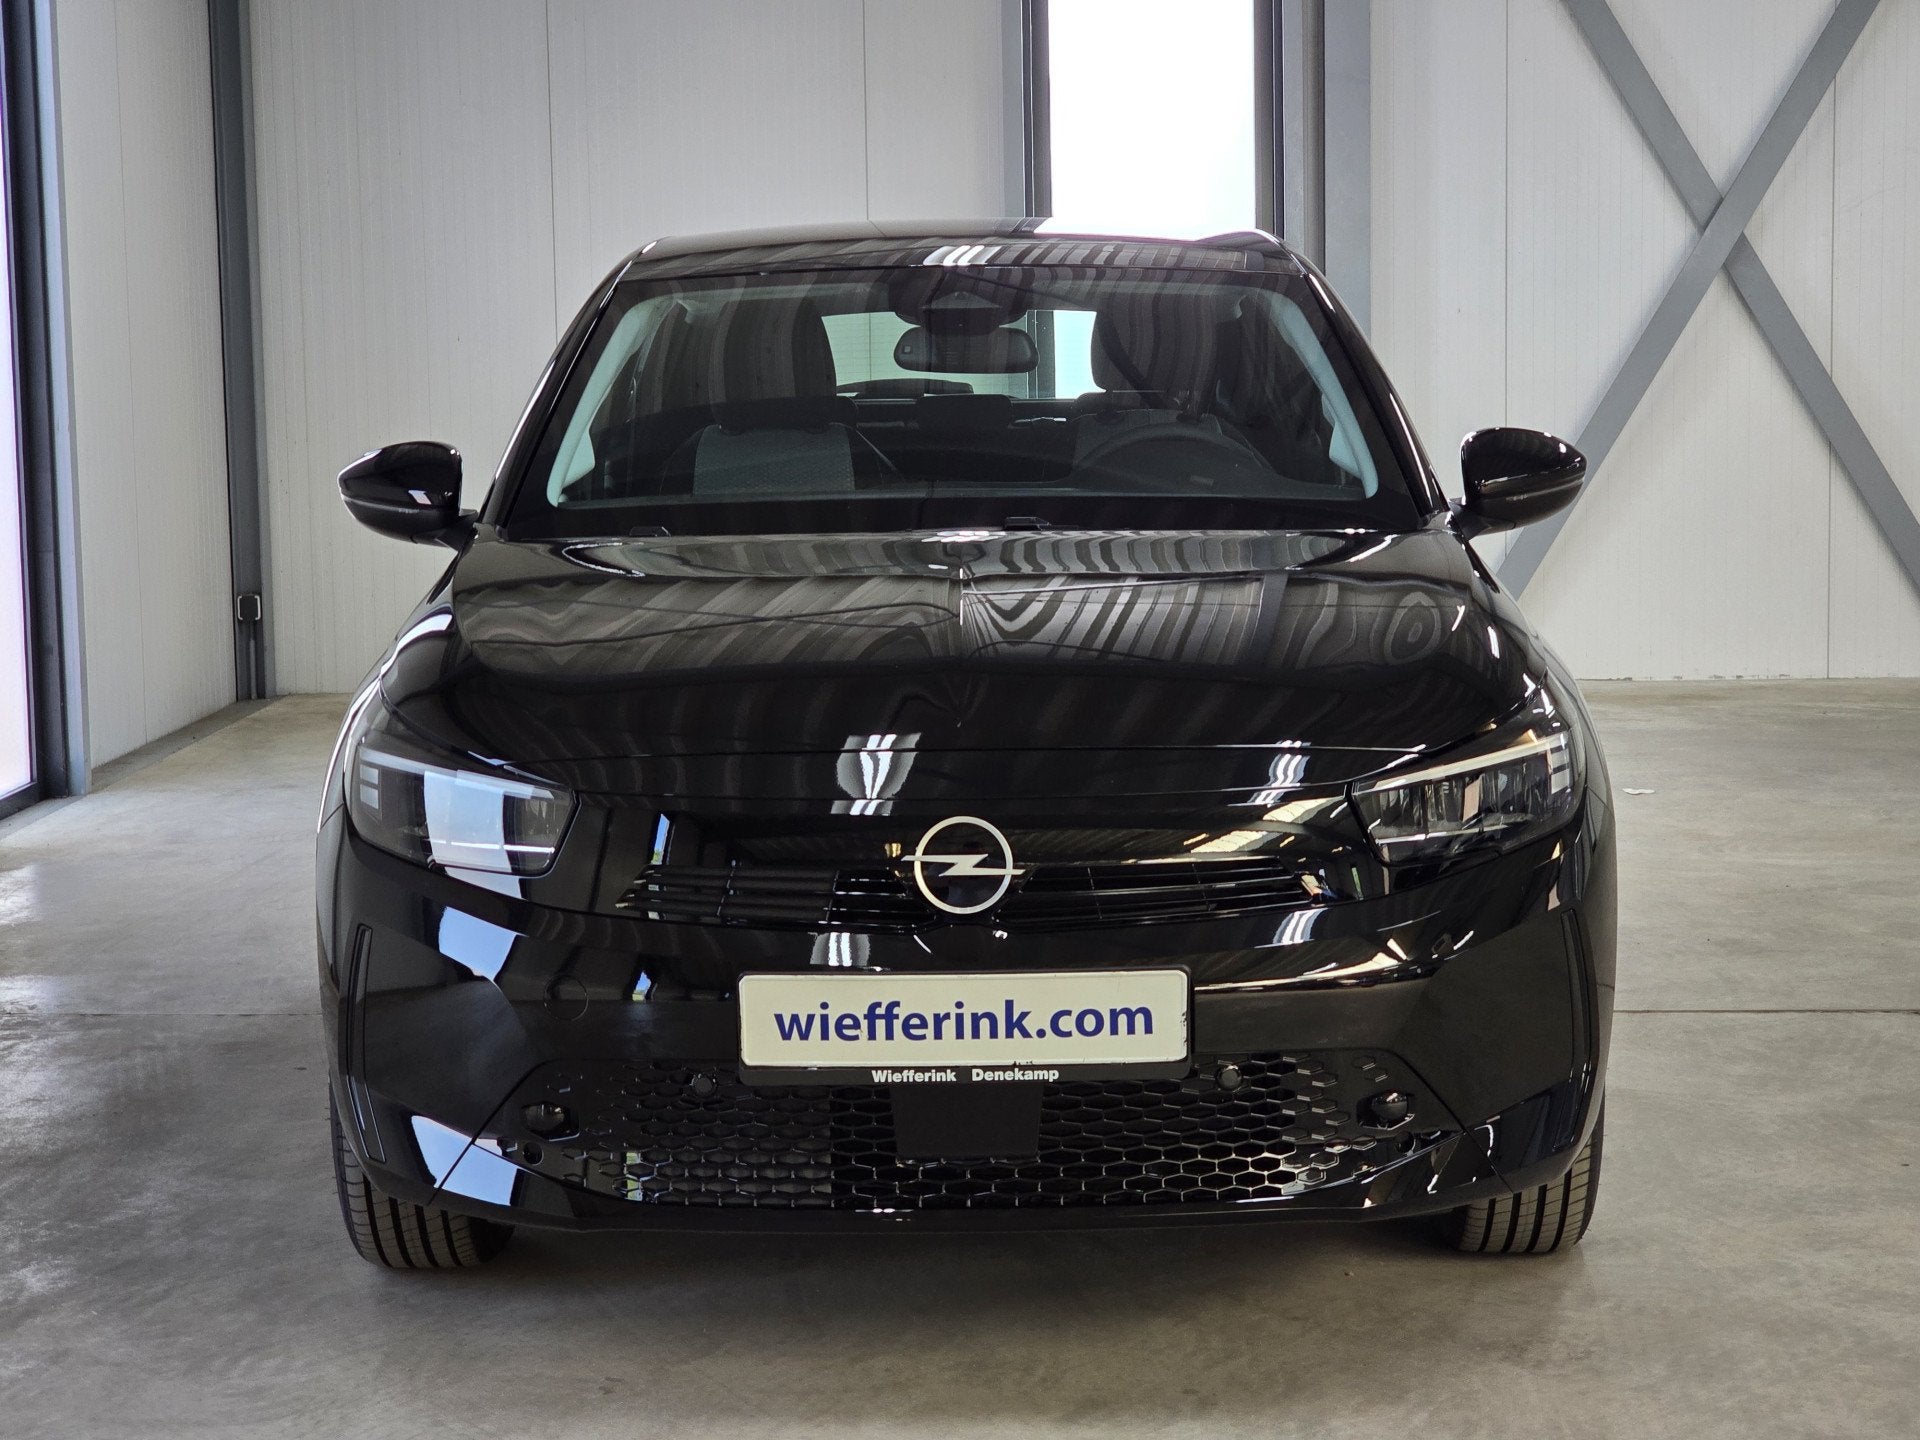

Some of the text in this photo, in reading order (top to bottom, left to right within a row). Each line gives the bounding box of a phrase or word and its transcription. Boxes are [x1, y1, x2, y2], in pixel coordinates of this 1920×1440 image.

[774, 1000, 1153, 1041] wiefferink.com
[871, 1068, 1059, 1083] Wiefferink Denekamp
